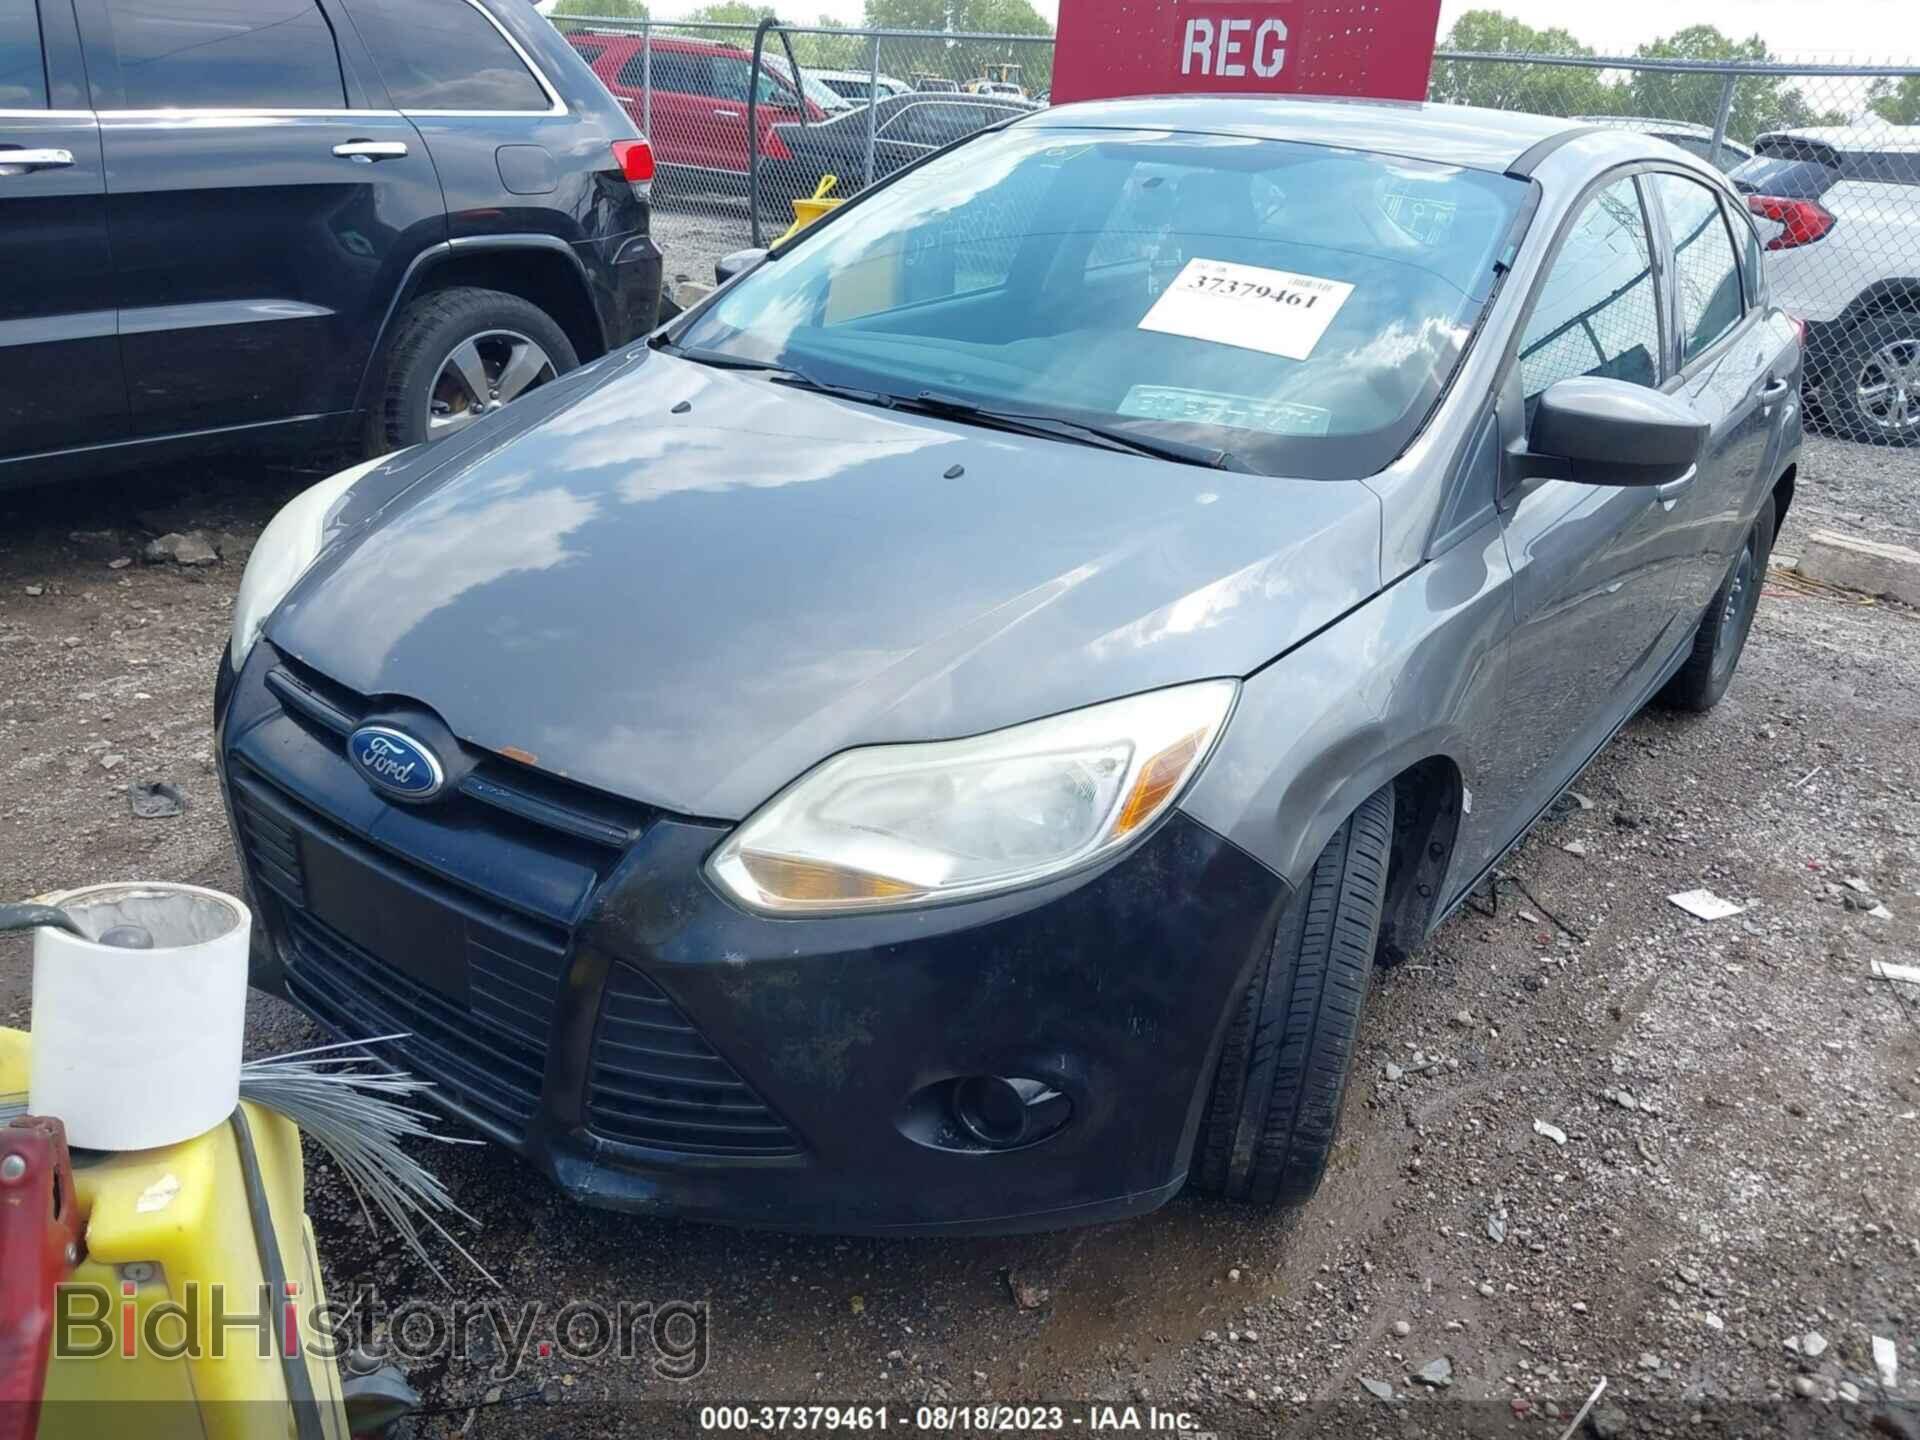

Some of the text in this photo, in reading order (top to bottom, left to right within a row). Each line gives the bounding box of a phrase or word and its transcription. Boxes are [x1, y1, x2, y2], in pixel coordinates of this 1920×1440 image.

[1181, 18, 1288, 78] REG
[1187, 274, 1320, 309] 37379461
[361, 736, 416, 783] Ford
